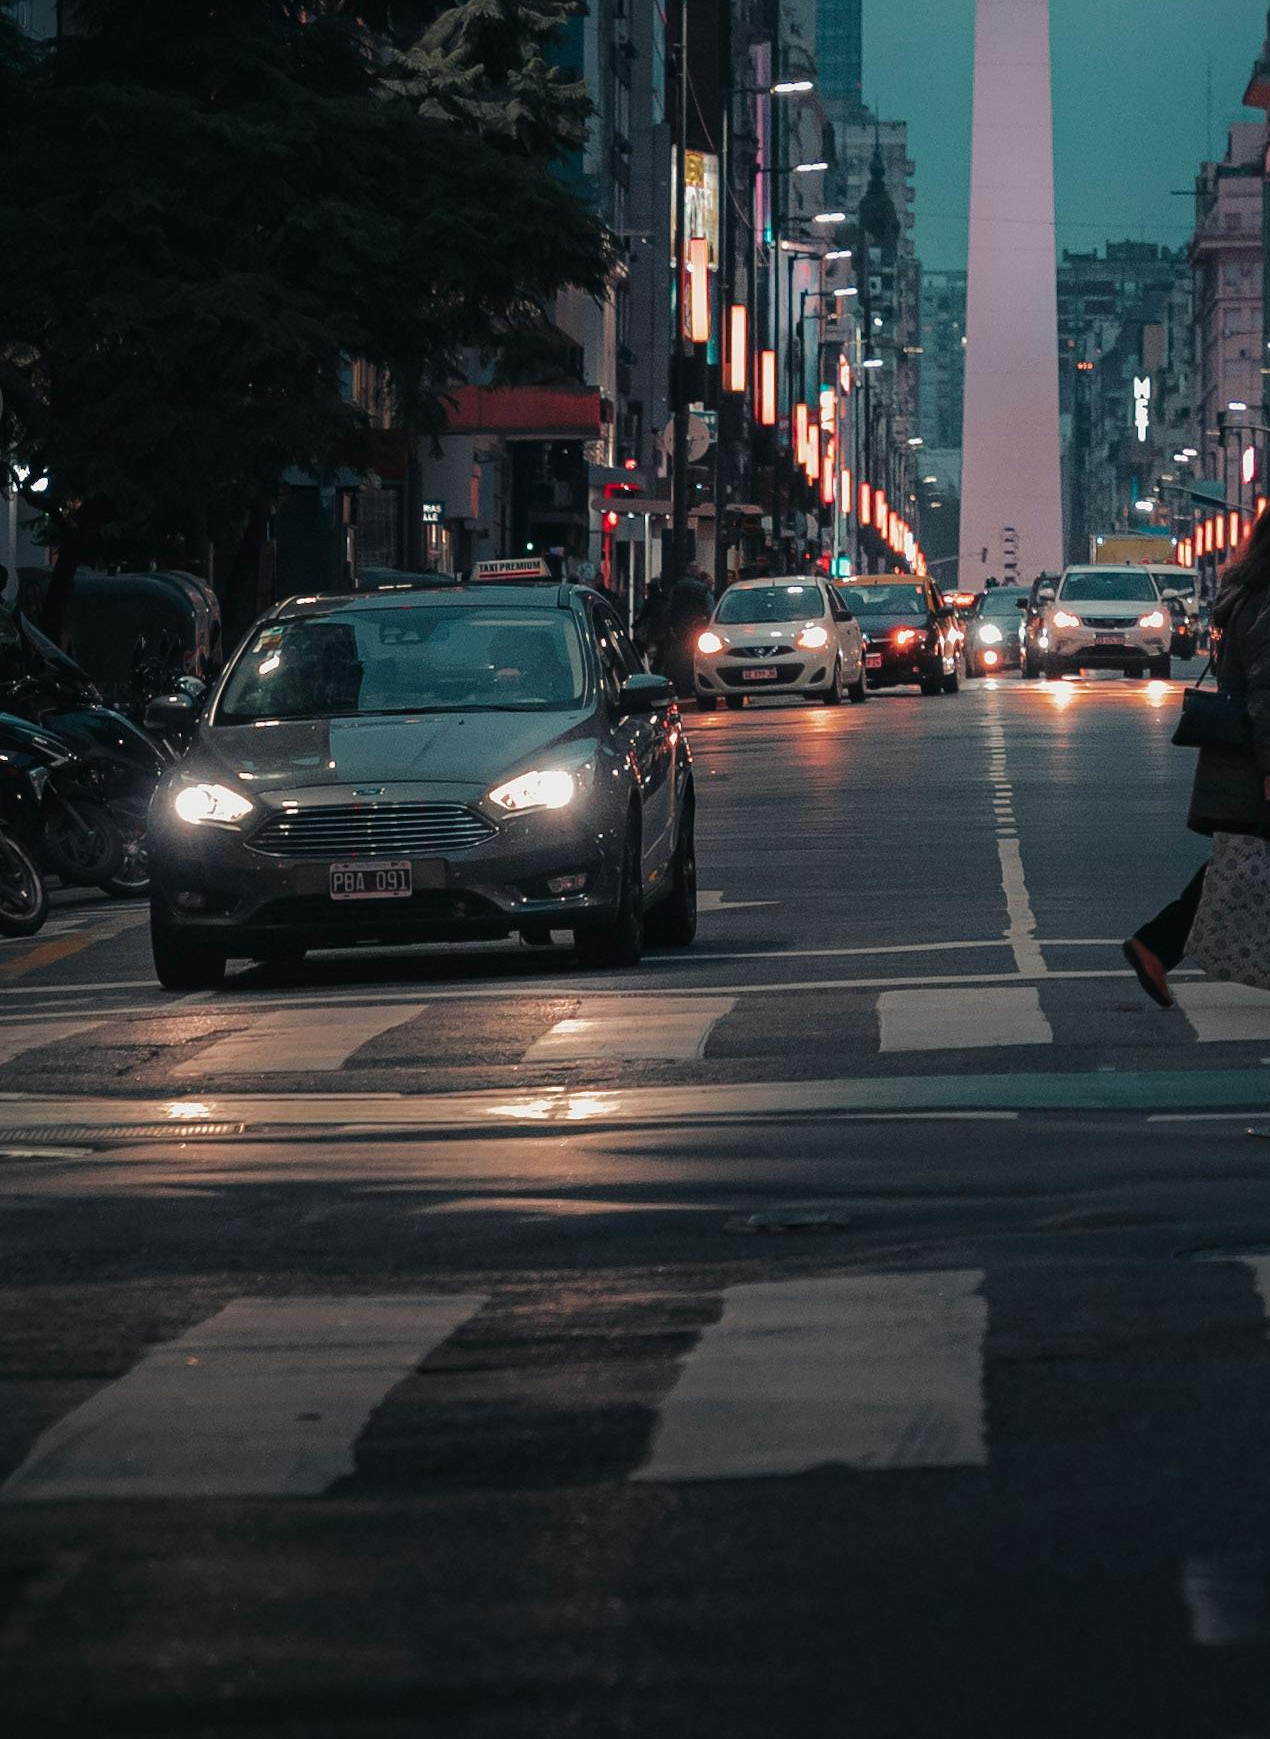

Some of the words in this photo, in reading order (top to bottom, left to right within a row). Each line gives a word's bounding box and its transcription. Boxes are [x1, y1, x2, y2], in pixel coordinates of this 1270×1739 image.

[479, 563, 498, 574] TAXI
[500, 561, 541, 572] PREMIUM
[333, 872, 365, 892] PBA
[376, 870, 408, 891] 091
